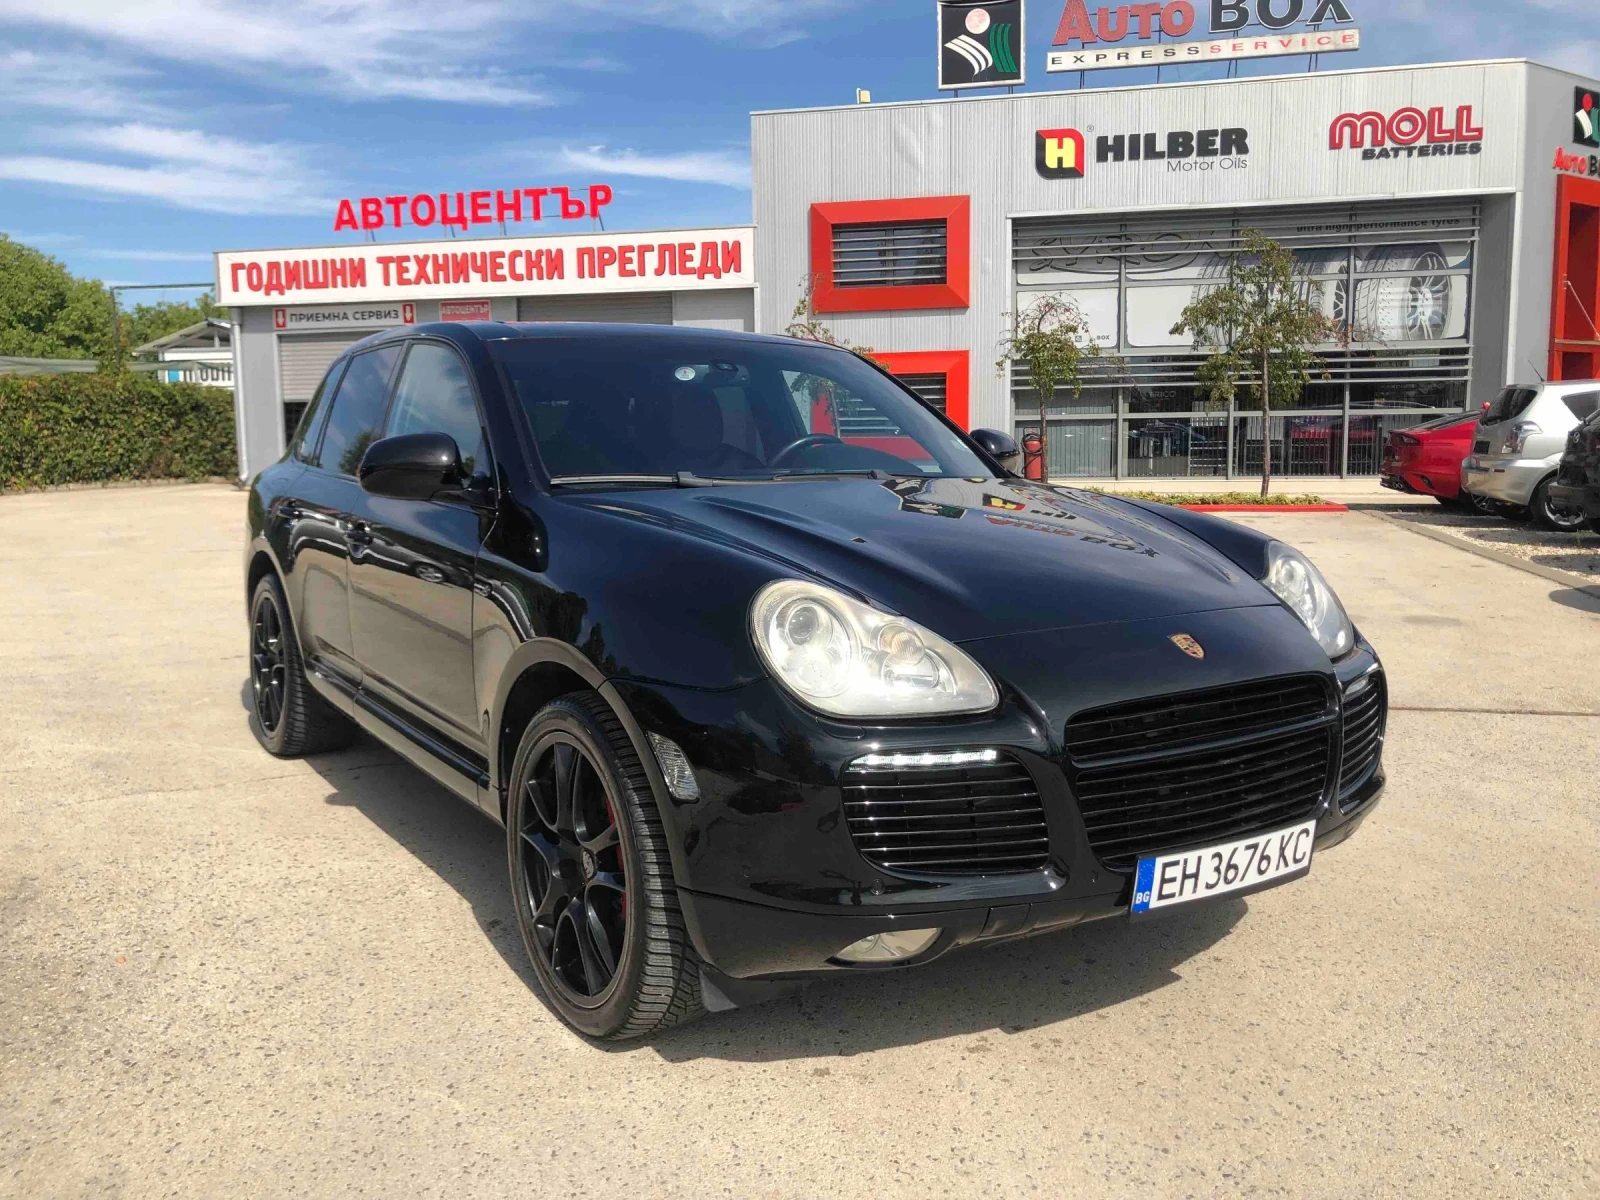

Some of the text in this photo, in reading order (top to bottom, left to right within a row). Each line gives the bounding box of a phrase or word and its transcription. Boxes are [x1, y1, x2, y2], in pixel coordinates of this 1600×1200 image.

[1096, 127, 1250, 163] HILBER
[1361, 142, 1483, 160] BATTERIES
[1167, 157, 1248, 172] Motor Oils
[334, 184, 613, 231] АВТОЦЕНТЪР
[231, 240, 742, 296] ГОДИШНИ ТЕХНИЧЕСКИ ПРЕГЛЕДИ
[290, 309, 399, 323] ПРИЕМНА СЕРВИЗ
[1157, 827, 1310, 901] EH 3676 KC
[1135, 891, 1150, 905] BG
